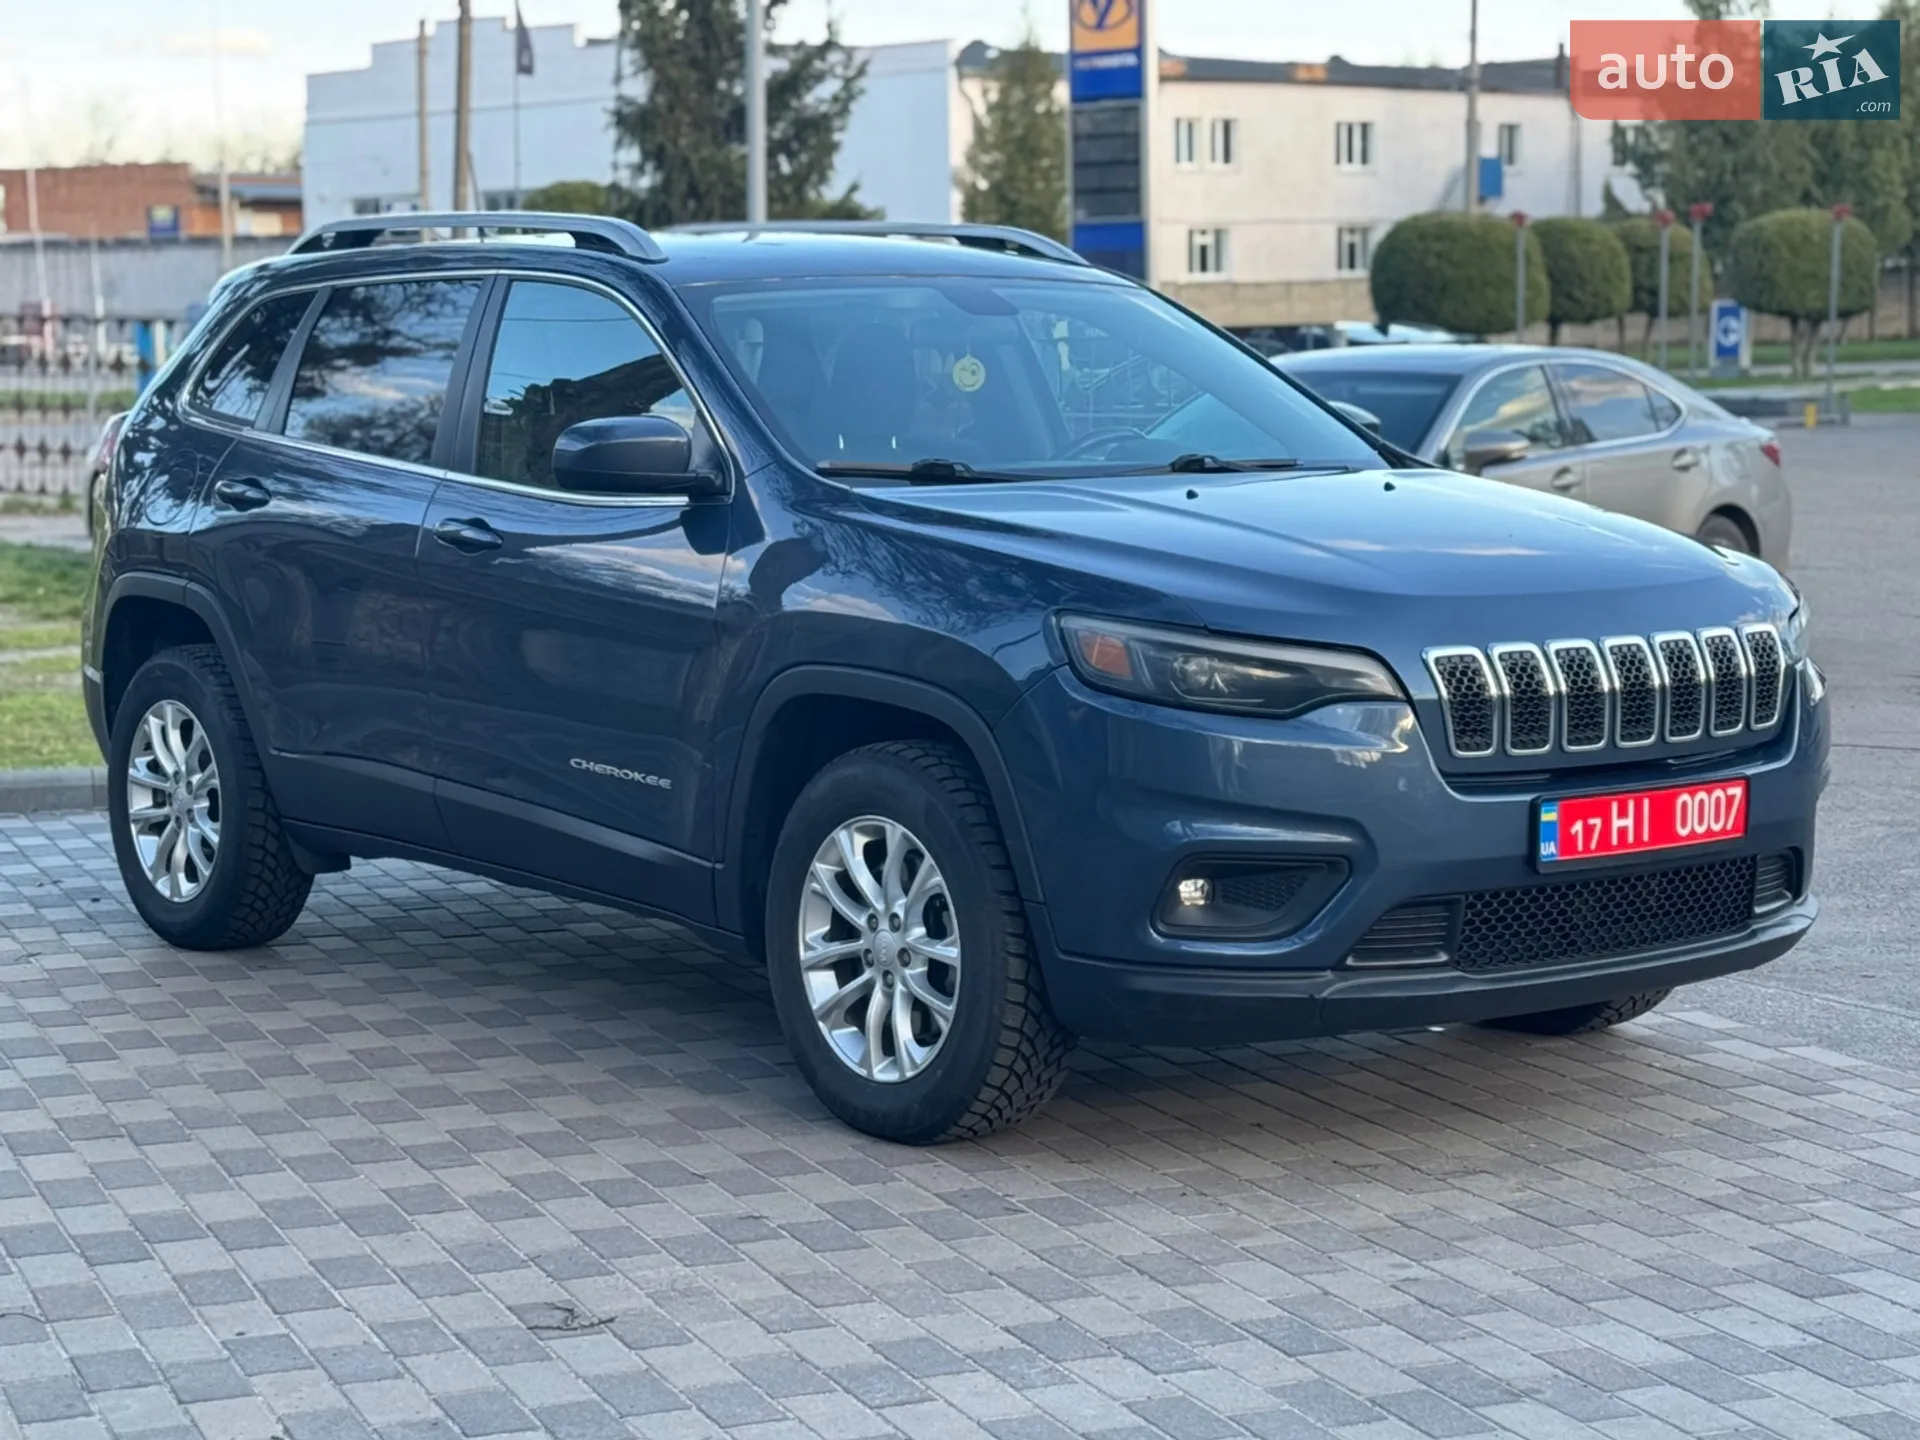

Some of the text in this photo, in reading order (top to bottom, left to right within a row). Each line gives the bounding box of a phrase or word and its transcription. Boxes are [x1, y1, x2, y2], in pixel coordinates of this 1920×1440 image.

[569, 758, 672, 790] CHEROKEE
[1675, 786, 1743, 837] 0007
[1540, 842, 1557, 855] UA
